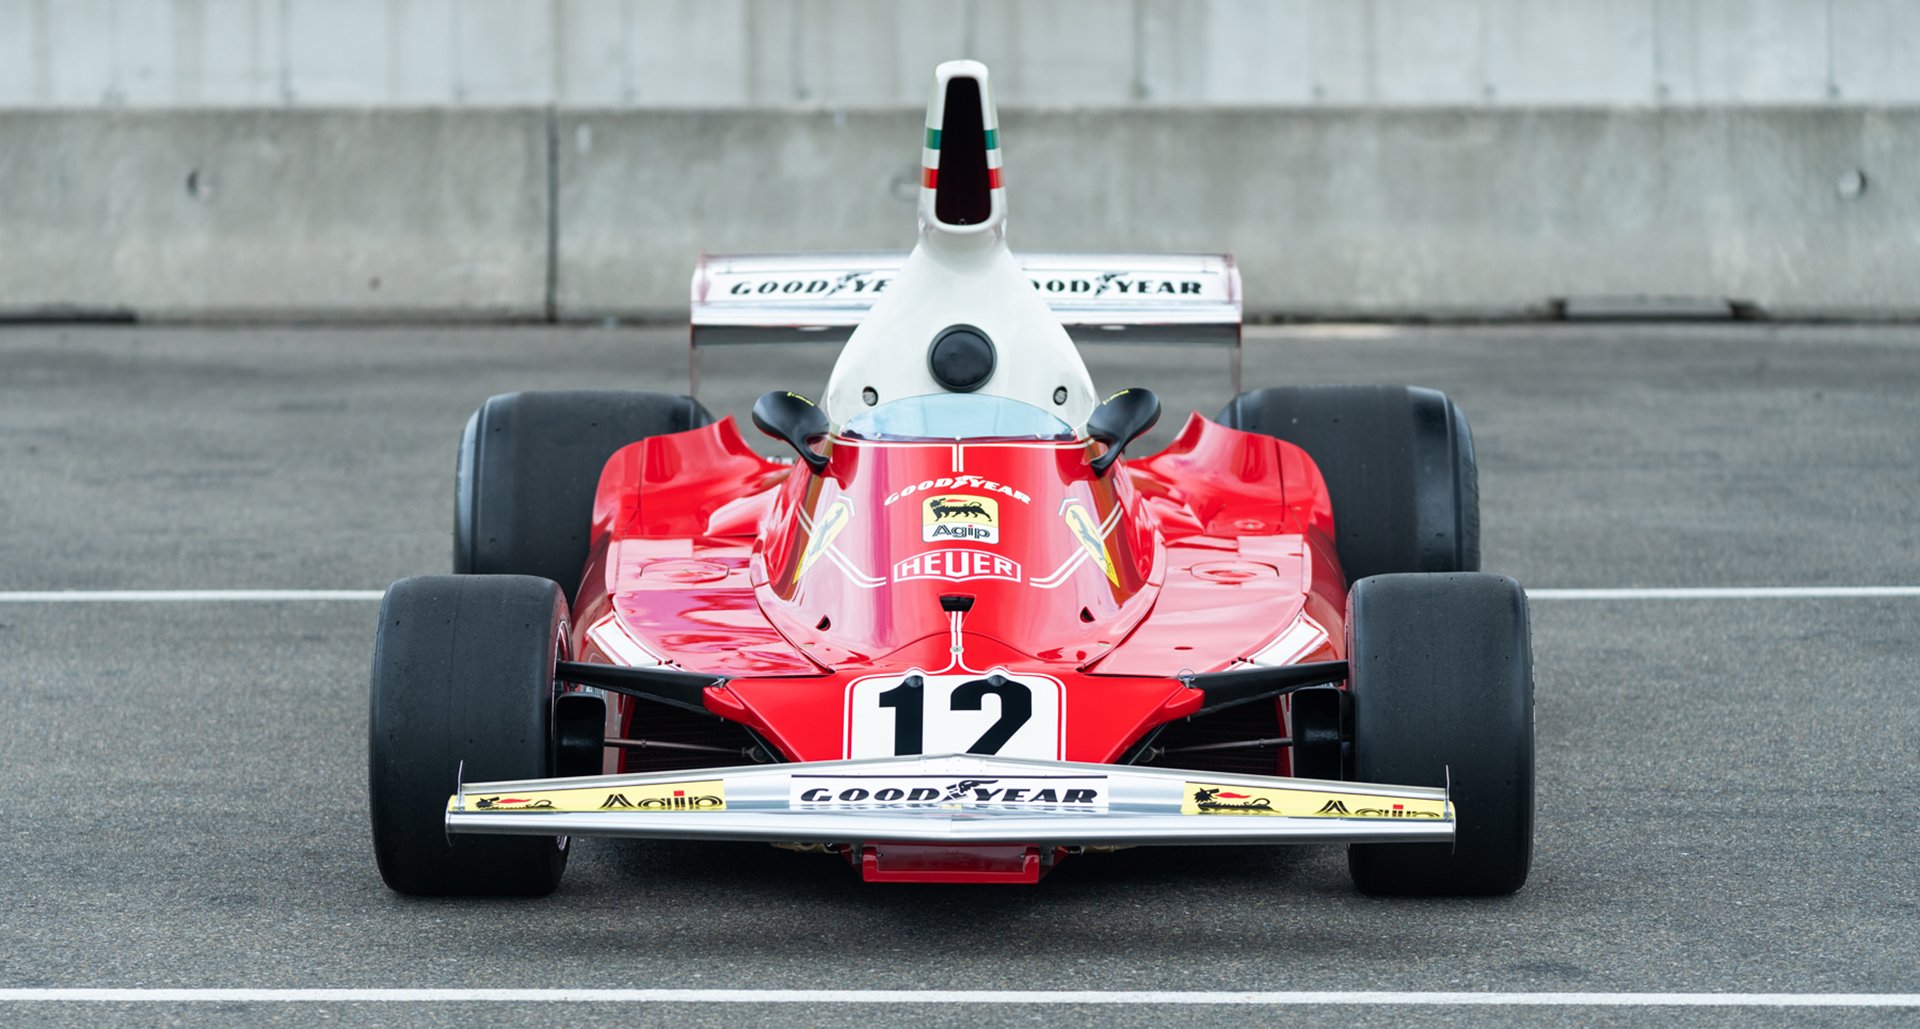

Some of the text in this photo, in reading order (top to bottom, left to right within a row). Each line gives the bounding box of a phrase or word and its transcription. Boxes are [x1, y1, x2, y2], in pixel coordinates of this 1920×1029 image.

[730, 277, 893, 295] GOODYE
[1030, 277, 1202, 294] ODYEAR
[884, 476, 1031, 506] GOODYEAR
[932, 524, 991, 539] Agip
[901, 552, 1013, 577] HEUER
[879, 675, 1032, 756] 12
[800, 784, 1098, 804] GOODYEAR
